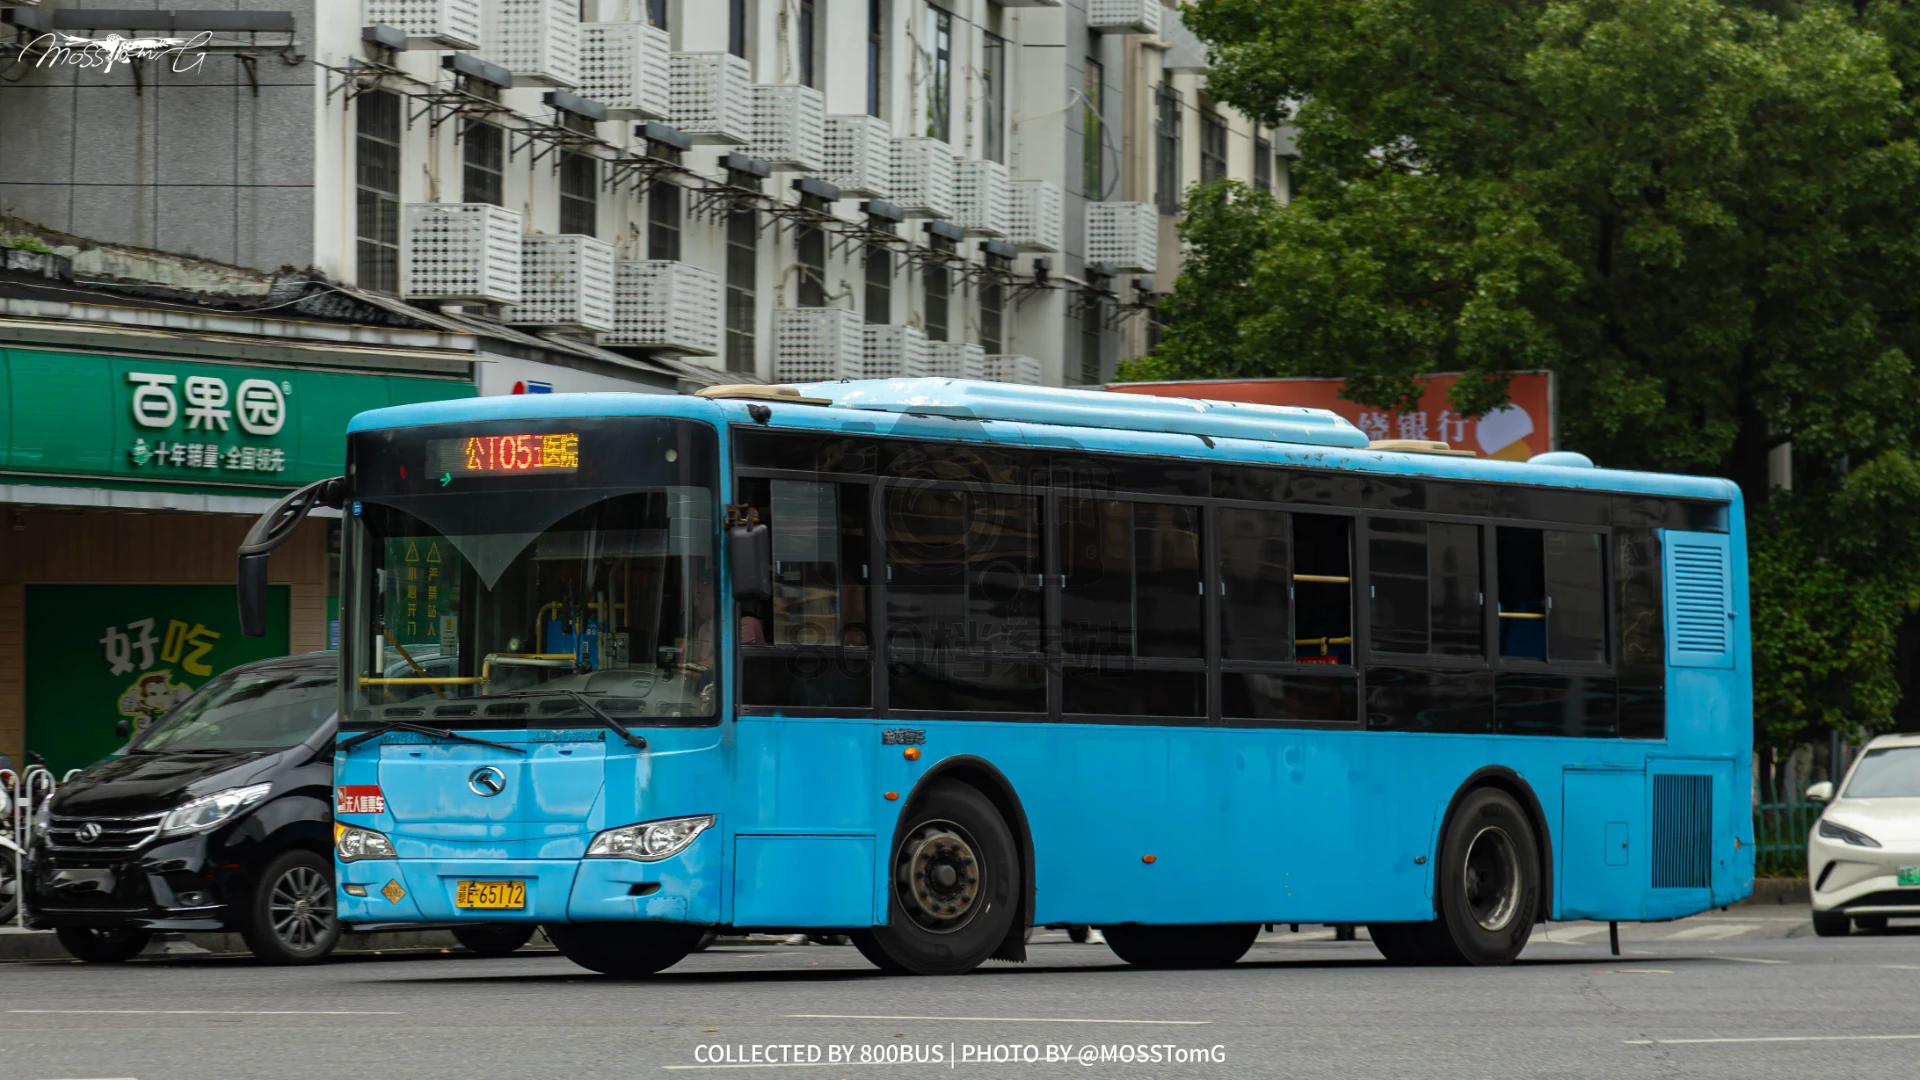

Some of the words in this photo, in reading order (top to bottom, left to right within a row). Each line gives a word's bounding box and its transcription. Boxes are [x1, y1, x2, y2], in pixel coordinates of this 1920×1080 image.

[129, 372, 285, 435] 百果园
[1358, 410, 1468, 442] 饶银行
[99, 617, 221, 677] 好吃
[346, 796, 385, 813] 无人售票车
